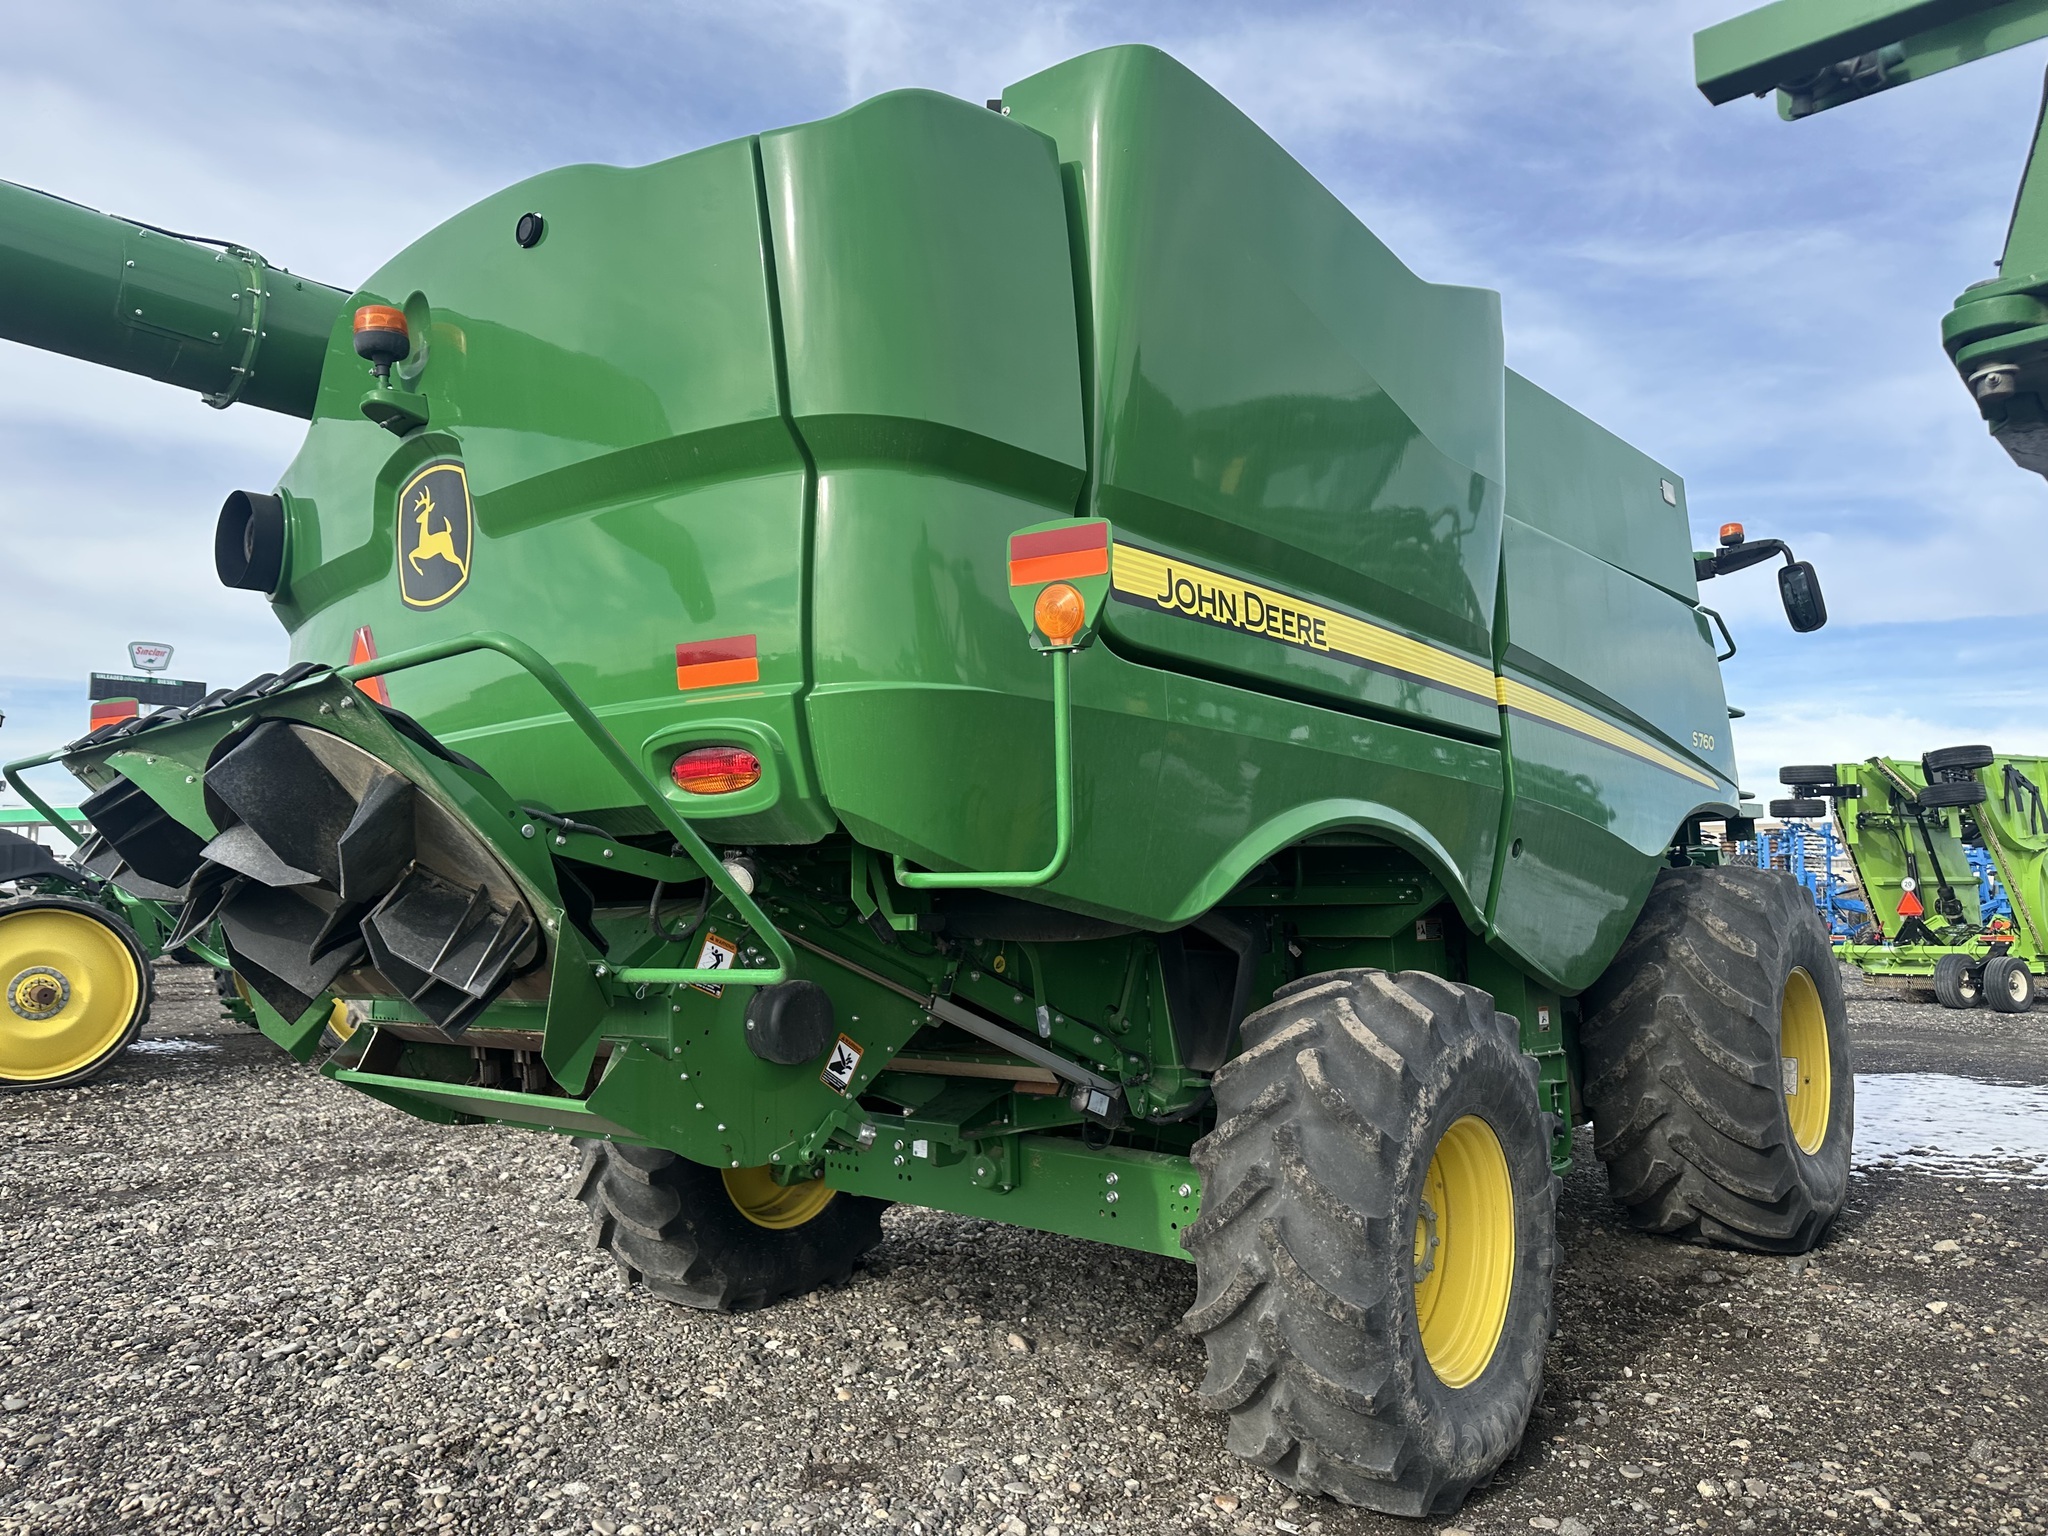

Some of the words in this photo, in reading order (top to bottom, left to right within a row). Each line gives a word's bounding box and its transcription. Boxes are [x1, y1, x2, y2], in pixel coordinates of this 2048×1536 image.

[1157, 568, 1237, 622] JOHN
[1244, 590, 1327, 647] DEERE
[135, 646, 167, 658] Sinclair
[96, 673, 124, 681] UNLEADED
[1692, 731, 1715, 751] S760
